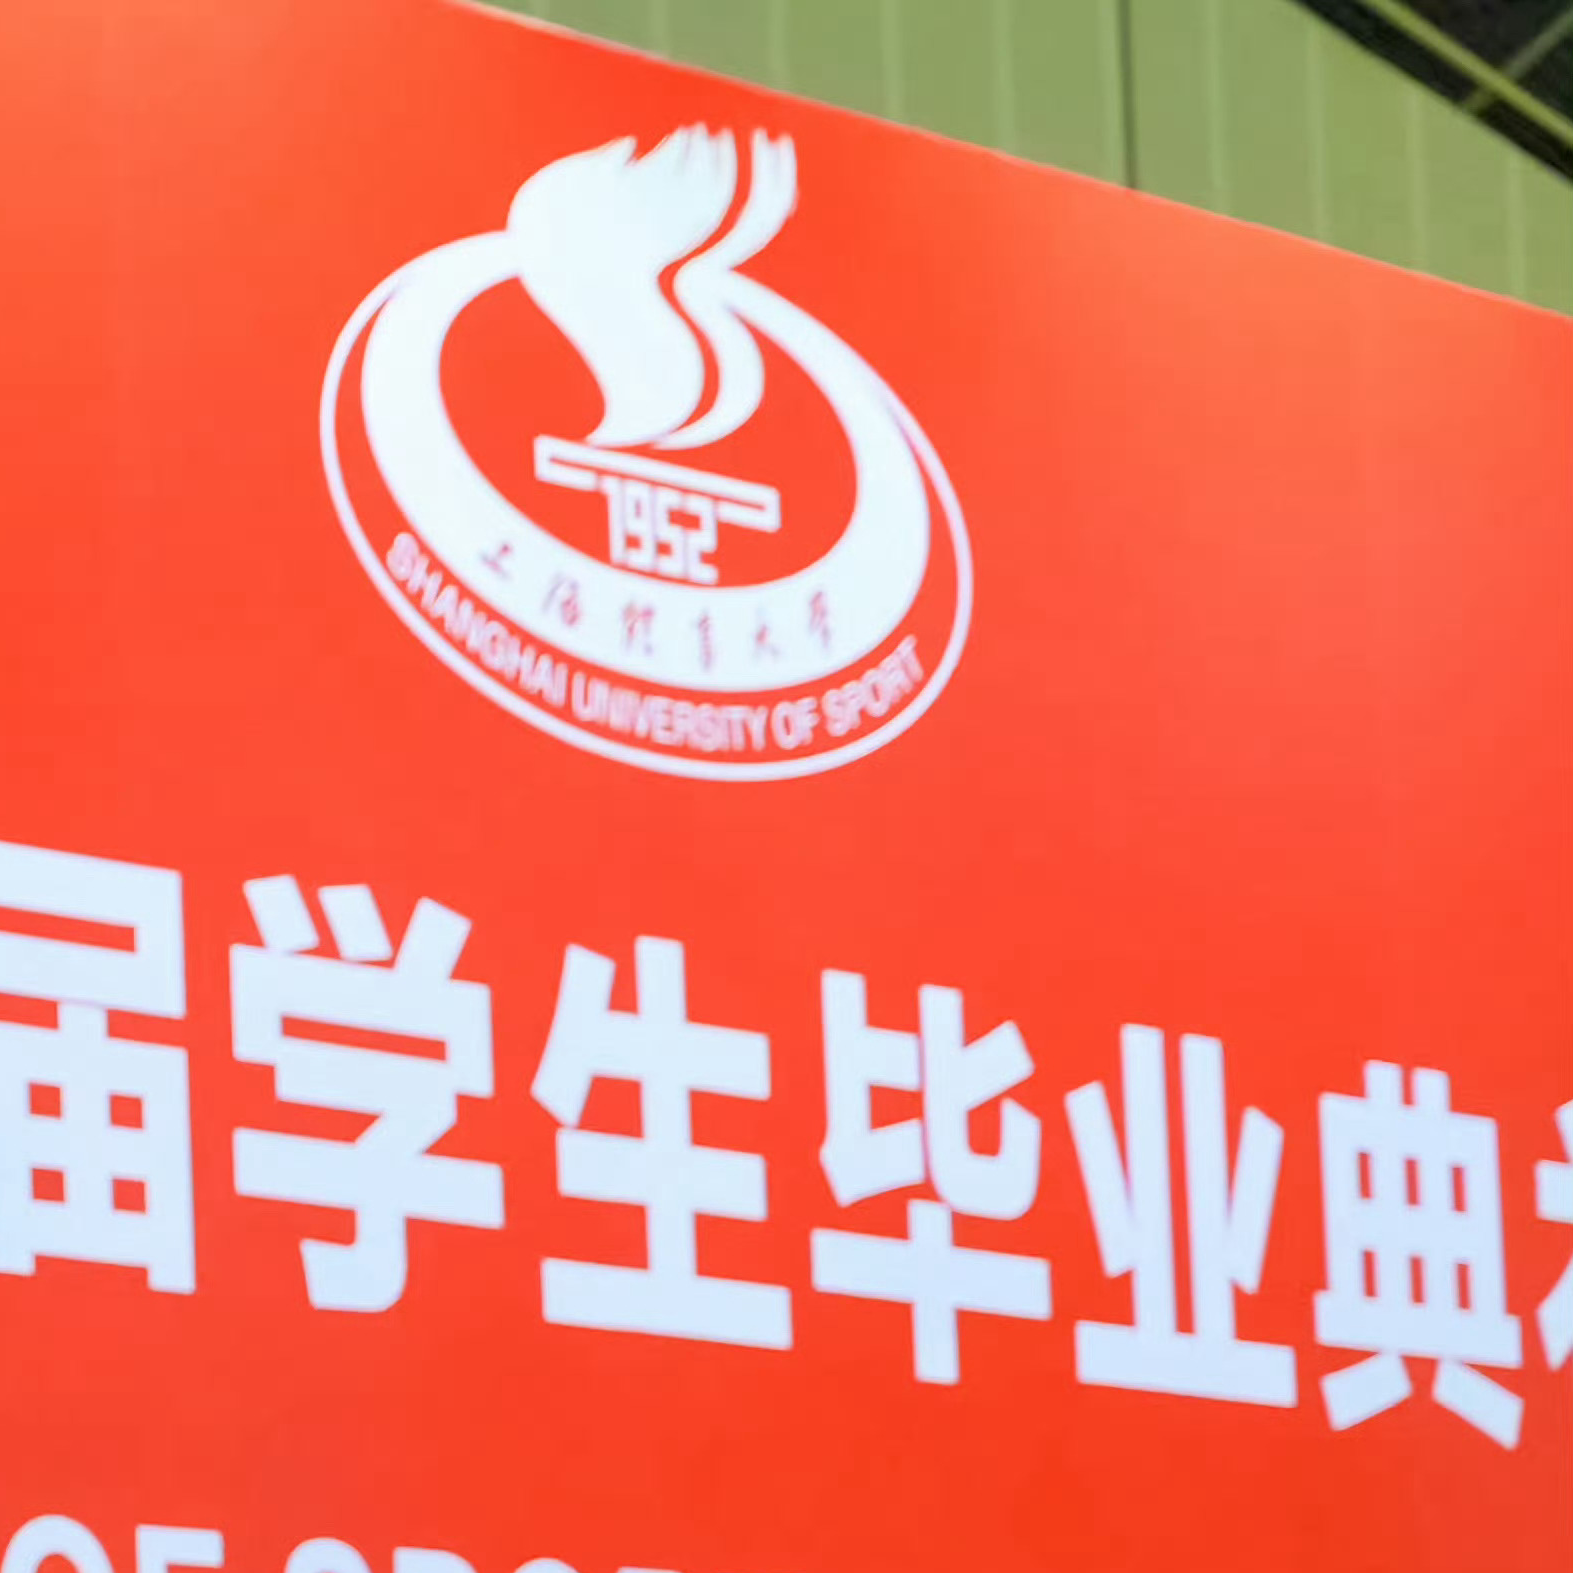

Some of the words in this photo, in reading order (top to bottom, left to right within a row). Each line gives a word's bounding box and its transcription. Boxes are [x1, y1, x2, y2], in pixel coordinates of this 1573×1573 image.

[606, 475, 718, 585] 1952
[386, 532, 568, 707] SHANGHAI
[571, 671, 769, 753] UNIVERSITY
[771, 696, 820, 750] OF
[821, 634, 924, 737] SPORT
